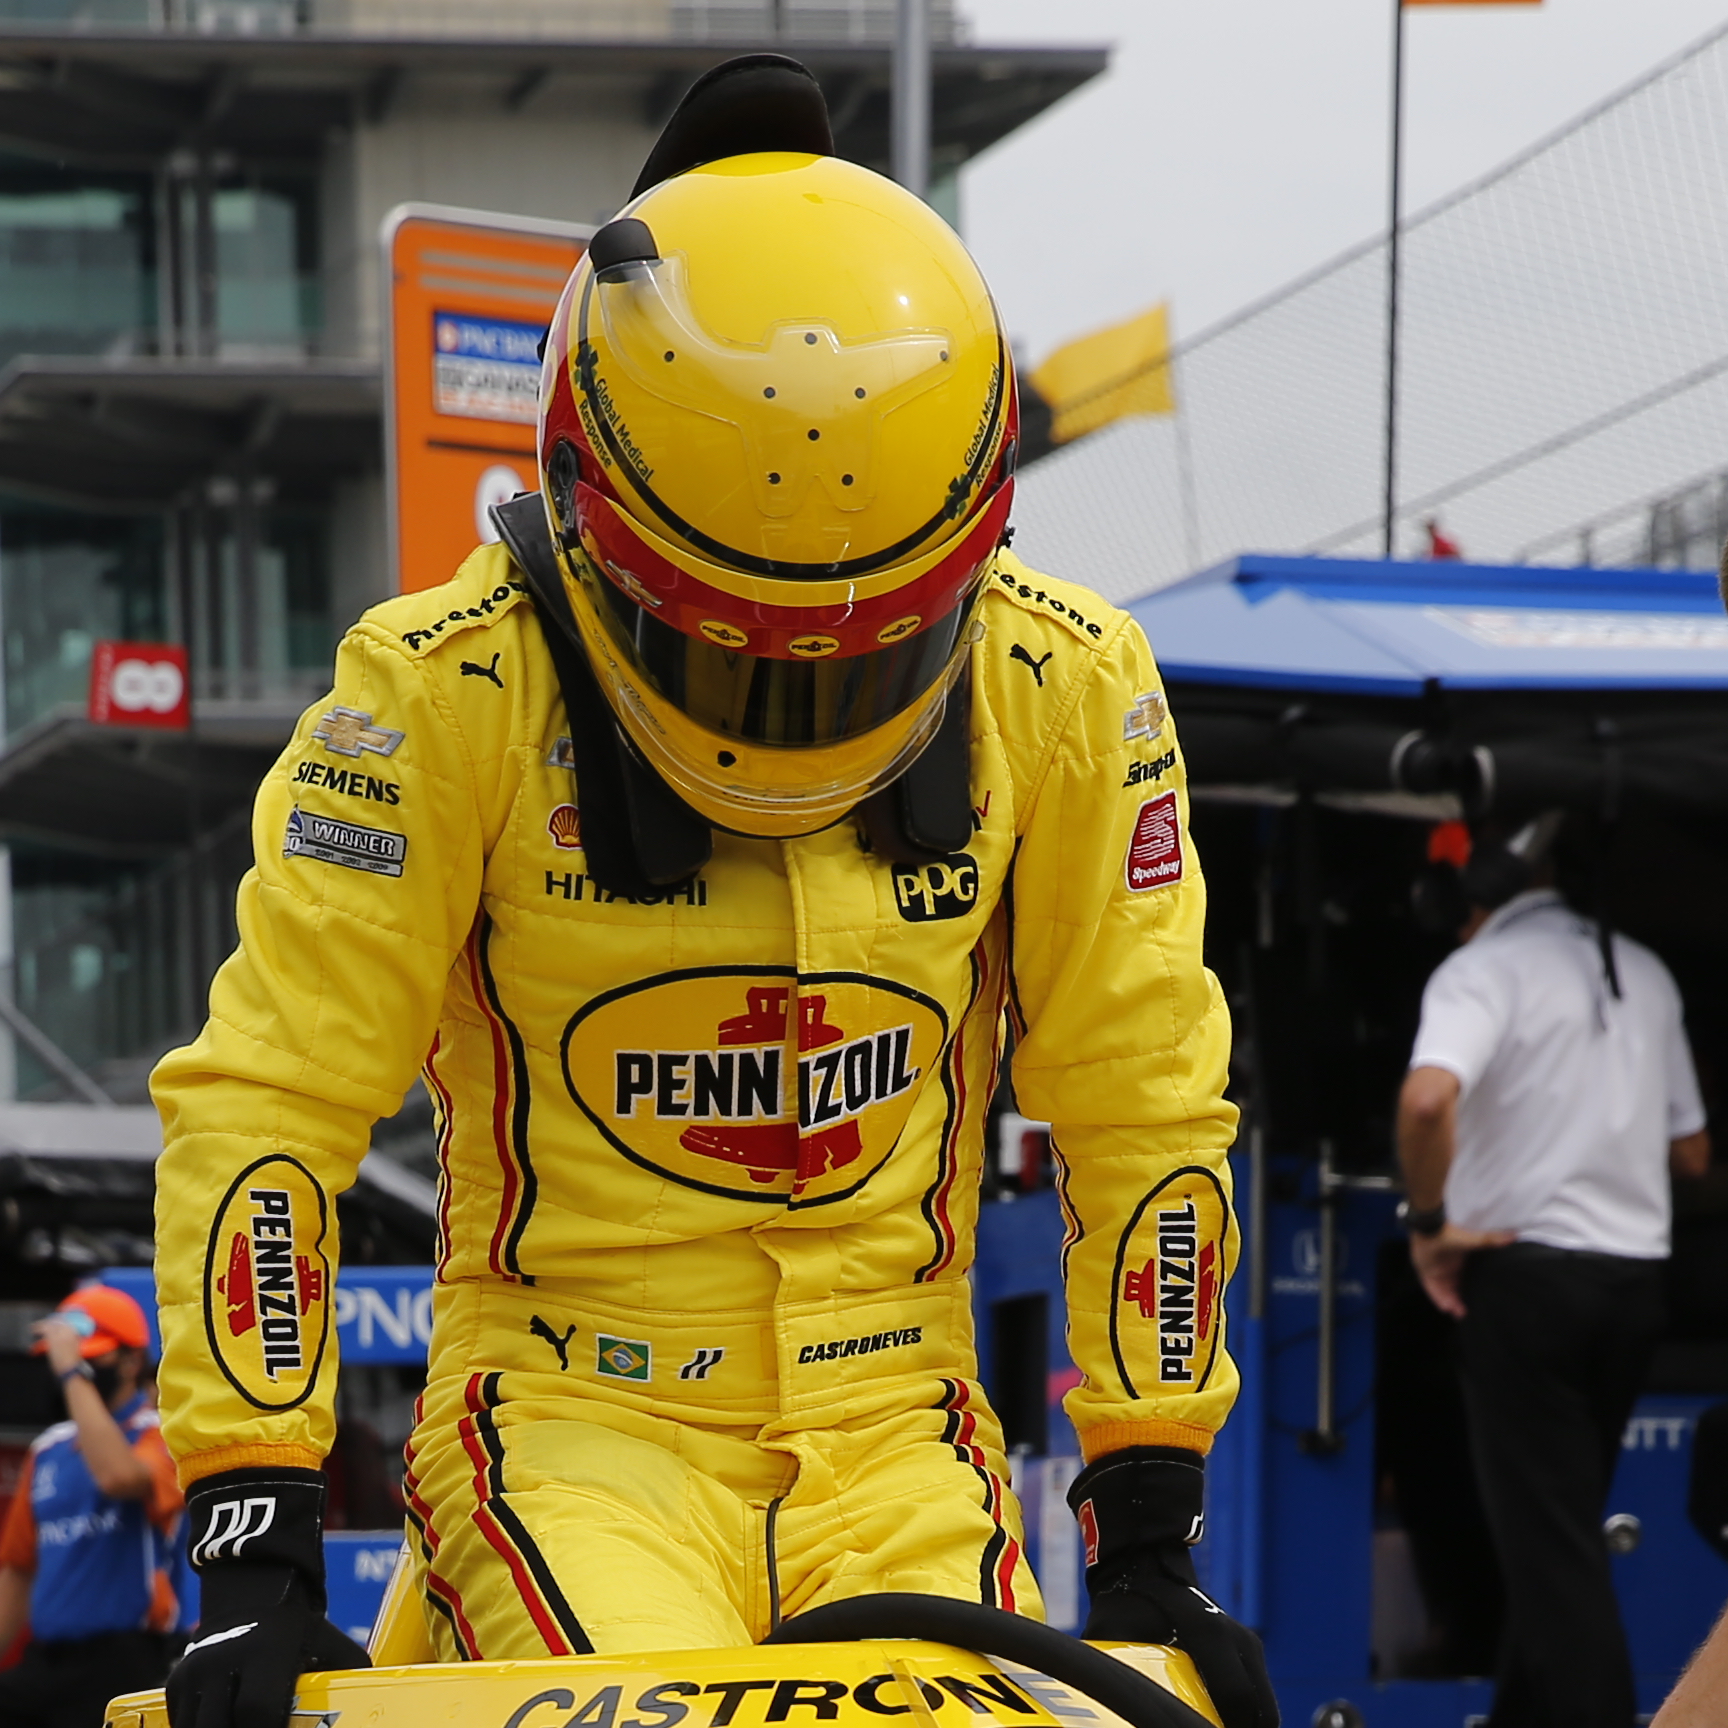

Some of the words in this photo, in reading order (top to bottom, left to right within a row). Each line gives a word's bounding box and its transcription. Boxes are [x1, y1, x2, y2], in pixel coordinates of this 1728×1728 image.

[578, 398, 612, 469] Response
[595, 377, 622, 427] Global
[615, 423, 656, 483] Medical
[963, 419, 987, 467] Global
[982, 361, 1001, 420] Medical
[975, 421, 1003, 488] Response
[113, 658, 183, 714] 8
[292, 761, 400, 805] SIEMENS
[313, 820, 396, 857] WINNER
[545, 870, 706, 908] HITAHI
[897, 861, 976, 915] PPG
[1132, 859, 1181, 883] Speedway
[248, 1188, 303, 1381] PENNZOIL
[1157, 1200, 1197, 1383] PENNZOIL
[797, 1326, 923, 1365] CASTRONEVES
